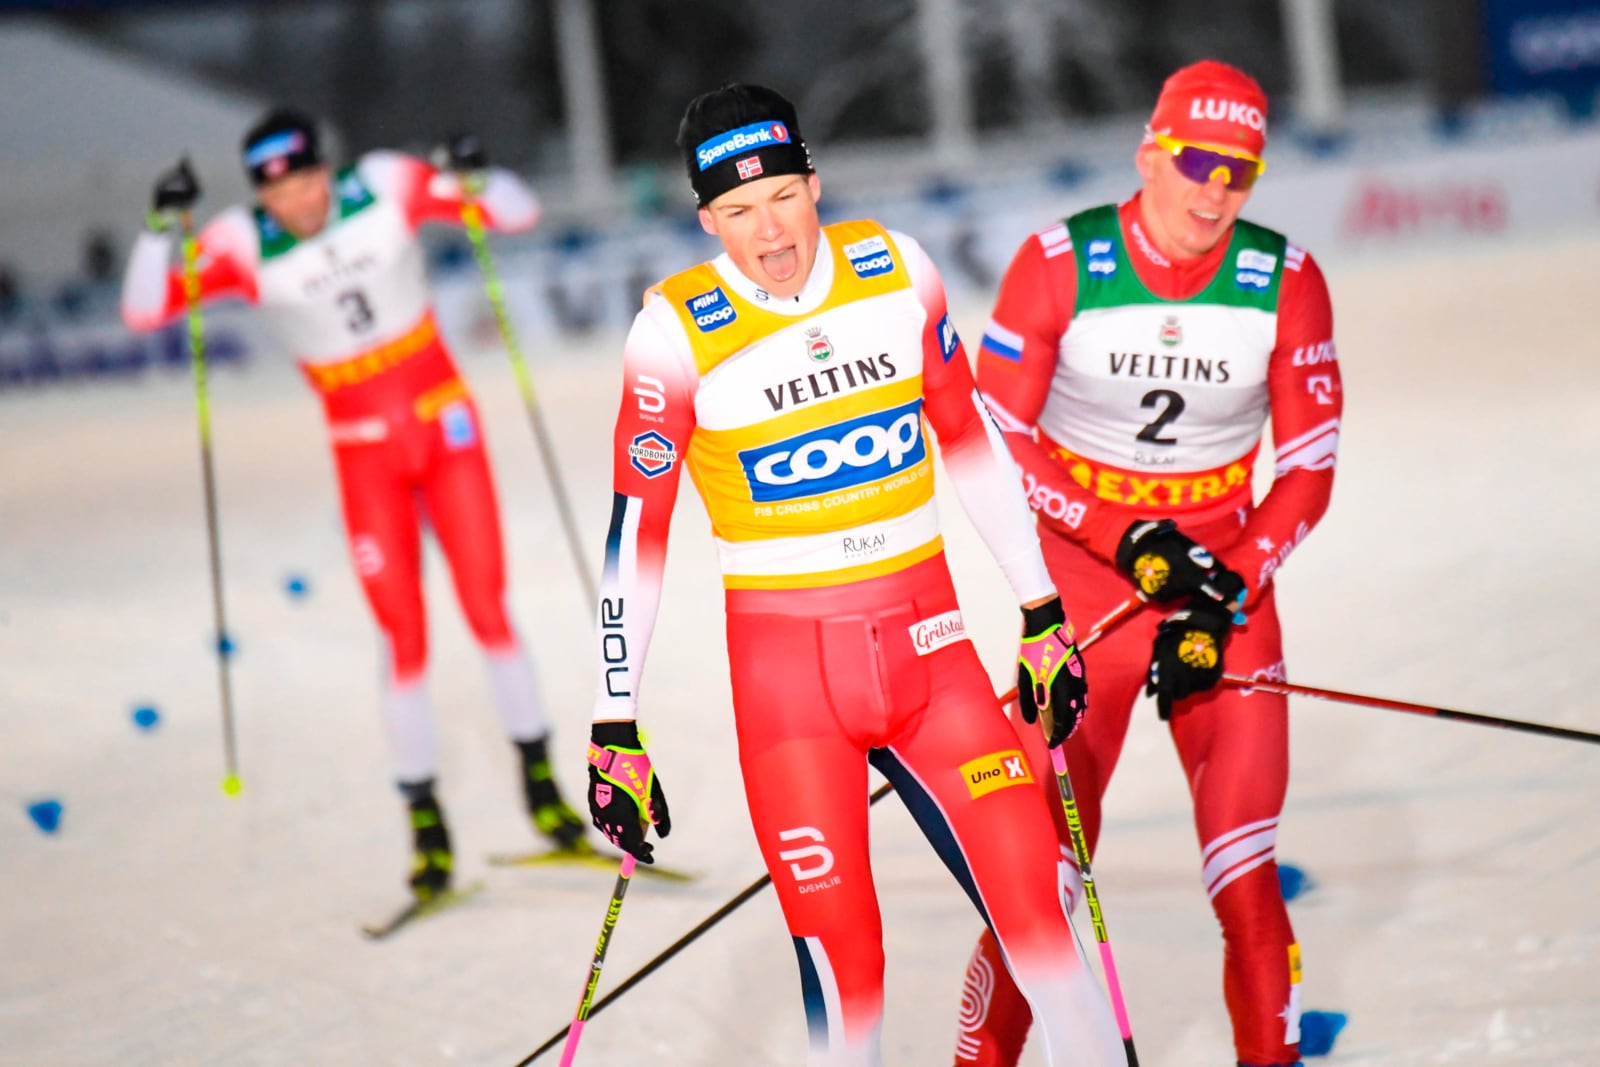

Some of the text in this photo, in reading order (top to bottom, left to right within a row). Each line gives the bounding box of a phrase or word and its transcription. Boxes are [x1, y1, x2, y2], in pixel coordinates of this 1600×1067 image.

[1189, 97, 1266, 136] LUKO
[698, 128, 772, 166] SpareBank
[854, 255, 892, 273] coop
[337, 286, 374, 336] 3
[692, 291, 719, 312] MINI
[696, 305, 734, 327] coop
[764, 352, 897, 412] VELTINS
[1109, 352, 1230, 384] VELTINS
[1136, 389, 1186, 446] 2
[629, 446, 676, 461] NORDBOHUS
[753, 412, 920, 486] coop
[754, 506, 773, 517] FIS
[776, 502, 820, 516] CROSS
[823, 485, 880, 508] COUNTRY
[883, 471, 918, 492] WORLD
[1016, 462, 1087, 529] BOSC
[1096, 462, 1248, 506] EXTRA
[601, 597, 631, 698] NOR
[971, 756, 1025, 784] Uno X
